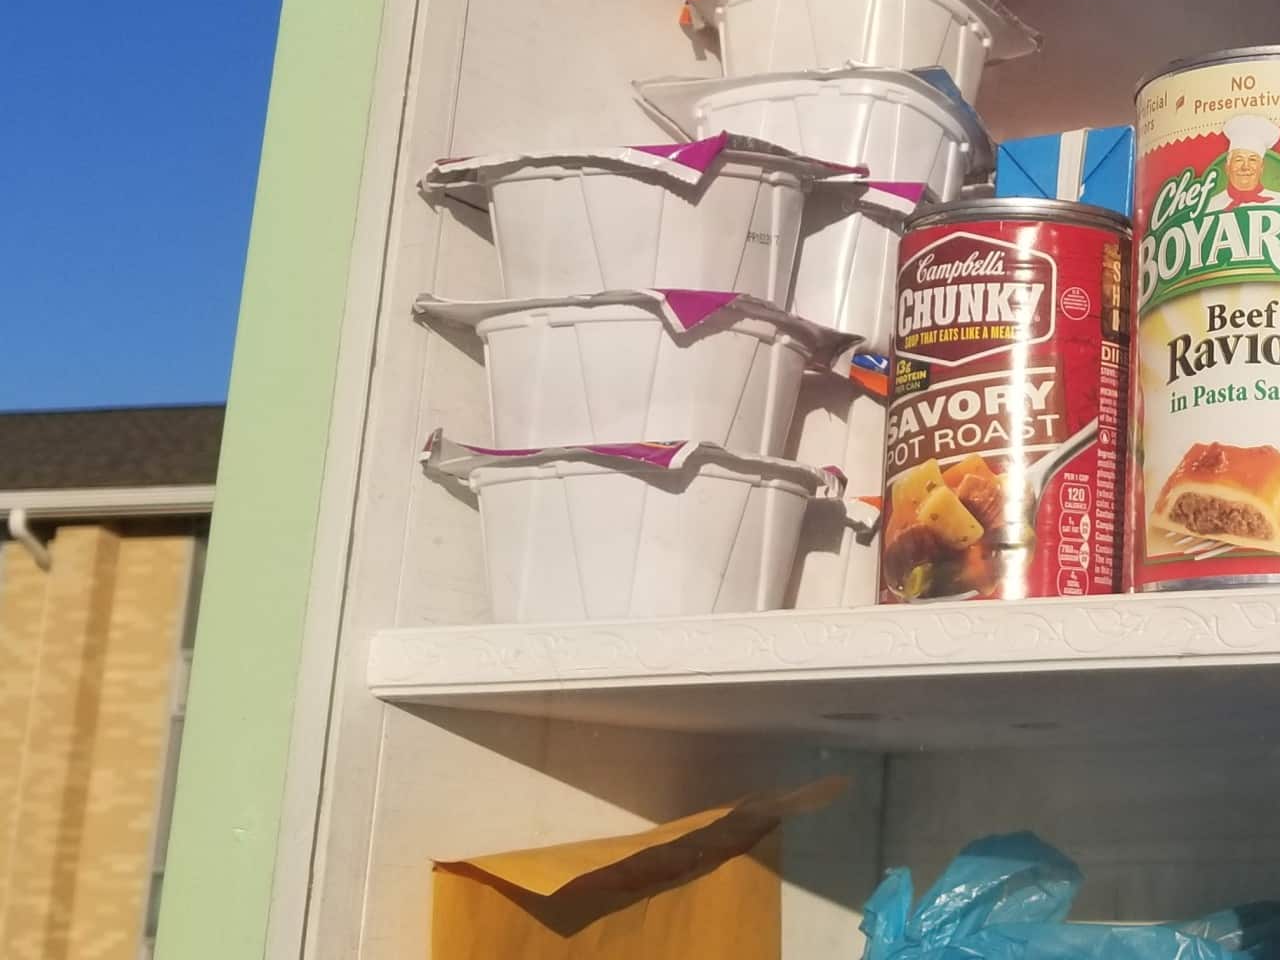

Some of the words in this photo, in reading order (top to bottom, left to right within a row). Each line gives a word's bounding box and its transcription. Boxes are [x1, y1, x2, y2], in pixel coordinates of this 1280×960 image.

[1231, 75, 1256, 92] NO
[1151, 168, 1218, 230] Chef
[898, 283, 1045, 337] CHUNKY
[1206, 300, 1279, 333] Beef
[920, 332, 938, 345] THAT
[939, 328, 959, 342] EATS
[961, 326, 980, 340] LIKE
[982, 325, 990, 339] A
[887, 381, 1056, 446] SAVORY
[1170, 392, 1187, 414] in
[1192, 383, 1248, 408] Pasta
[887, 435, 926, 465] POT
[934, 414, 1061, 453] ROAST
[1067, 487, 1085, 502] 120
